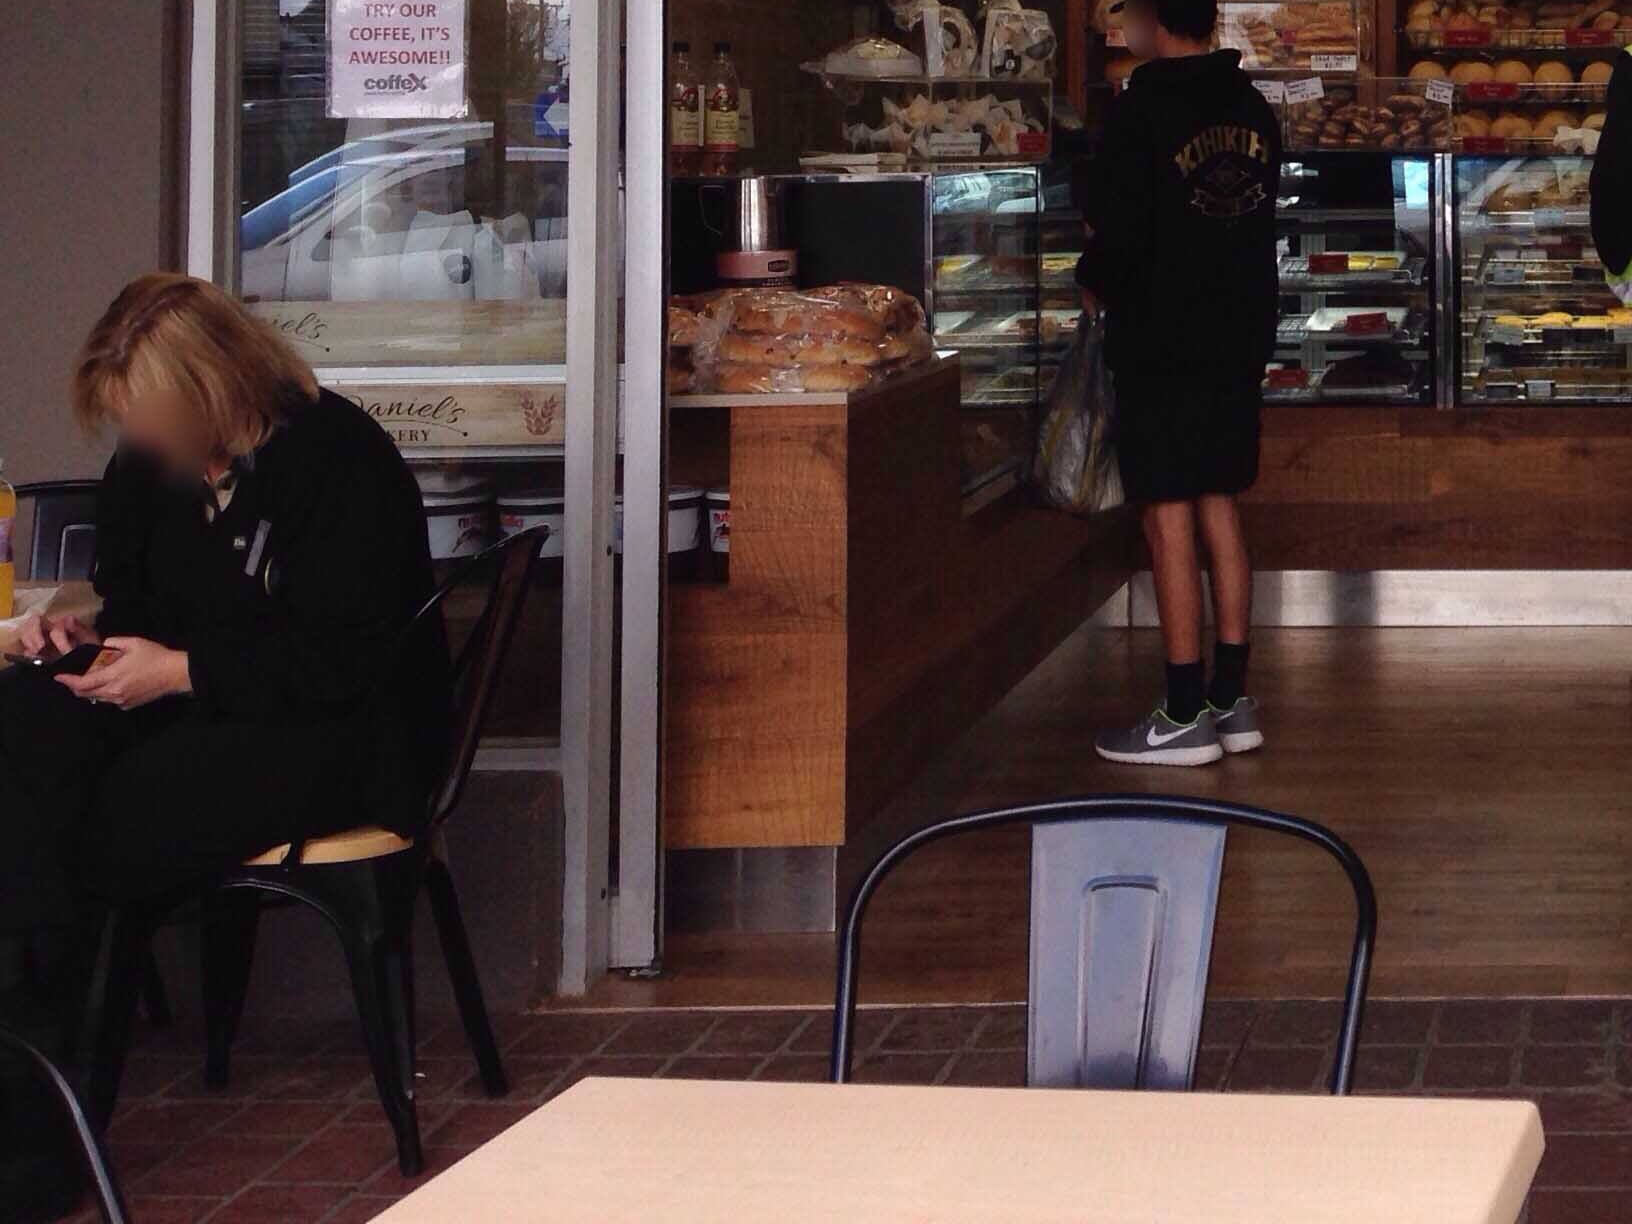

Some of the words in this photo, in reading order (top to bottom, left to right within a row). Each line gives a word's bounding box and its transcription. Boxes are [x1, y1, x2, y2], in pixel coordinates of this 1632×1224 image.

[364, 3, 394, 17] TRY
[400, 3, 436, 17] OUR
[350, 27, 415, 43] COFFEE,
[421, 27, 450, 41] IT'S
[349, 51, 451, 64] AWESOME!!
